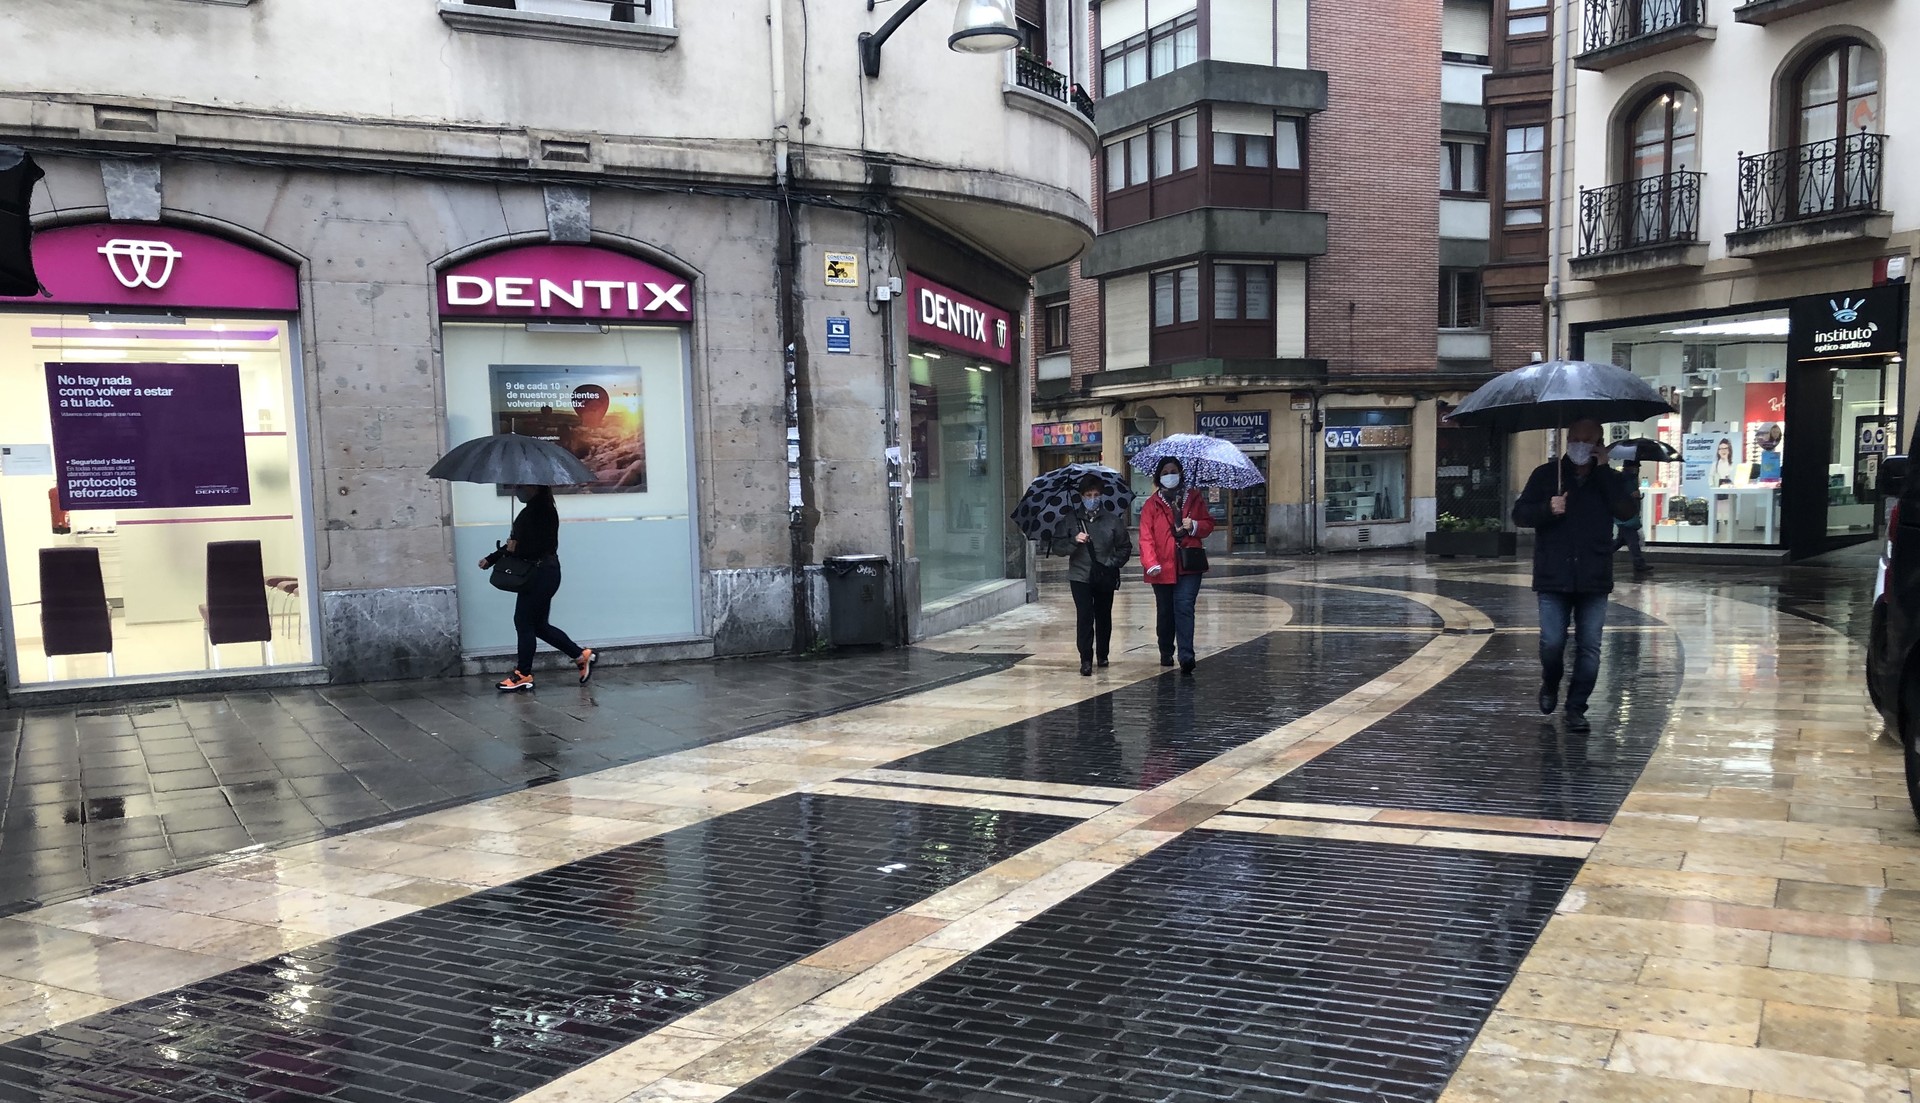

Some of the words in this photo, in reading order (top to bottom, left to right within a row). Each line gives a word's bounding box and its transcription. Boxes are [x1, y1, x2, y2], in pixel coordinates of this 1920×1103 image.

[446, 275, 689, 312] DENTIX
[921, 288, 987, 343] DENTIX
[1815, 327, 1873, 343] instituto
[1839, 341, 1872, 350] auditivo
[57, 375, 76, 385] No
[78, 375, 100, 387] hay
[102, 375, 132, 385] nada
[505, 382, 512, 390] 9
[513, 382, 525, 390] de
[526, 382, 548, 390] cada
[550, 382, 561, 390] 10
[59, 388, 94, 396] como
[96, 386, 132, 396] volver
[143, 387, 174, 396] estar
[506, 391, 518, 399] de
[519, 391, 558, 399] nuestros
[559, 391, 600, 401] pacientes
[70, 398, 83, 407] tu
[85, 397, 115, 407] lado.
[1232, 415, 1264, 426] MOVIL
[68, 477, 137, 490] protocolos
[69, 488, 138, 498] reforzados
